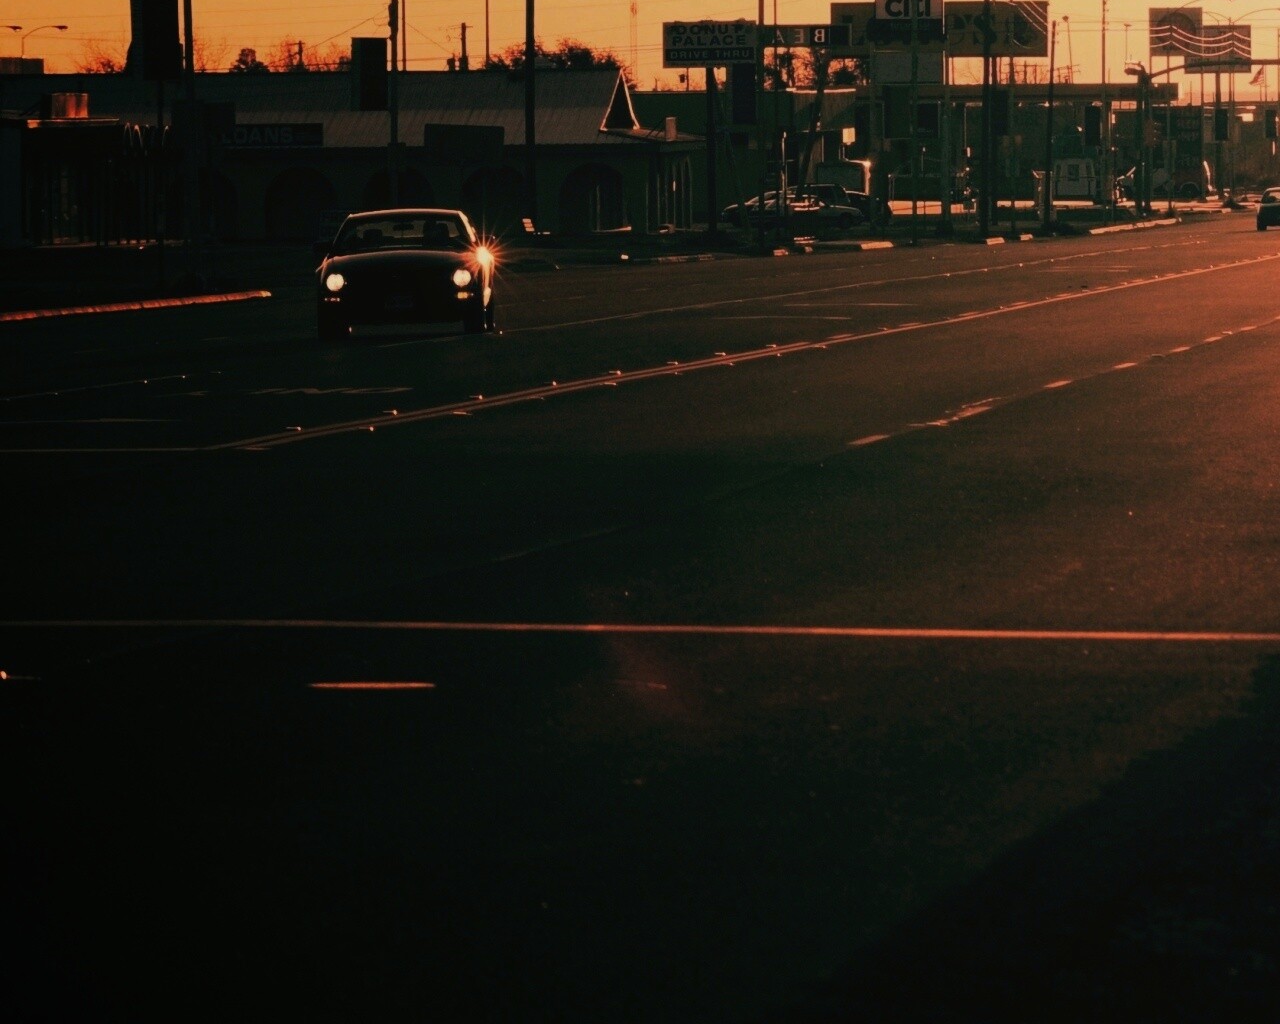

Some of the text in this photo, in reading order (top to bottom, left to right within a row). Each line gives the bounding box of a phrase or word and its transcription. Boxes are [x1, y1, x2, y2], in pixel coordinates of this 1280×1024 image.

[673, 23, 746, 36] DONUT
[672, 35, 747, 47] PALACE
[670, 49, 750, 60] DRIVE THRU
[221, 126, 294, 144] LOANS
